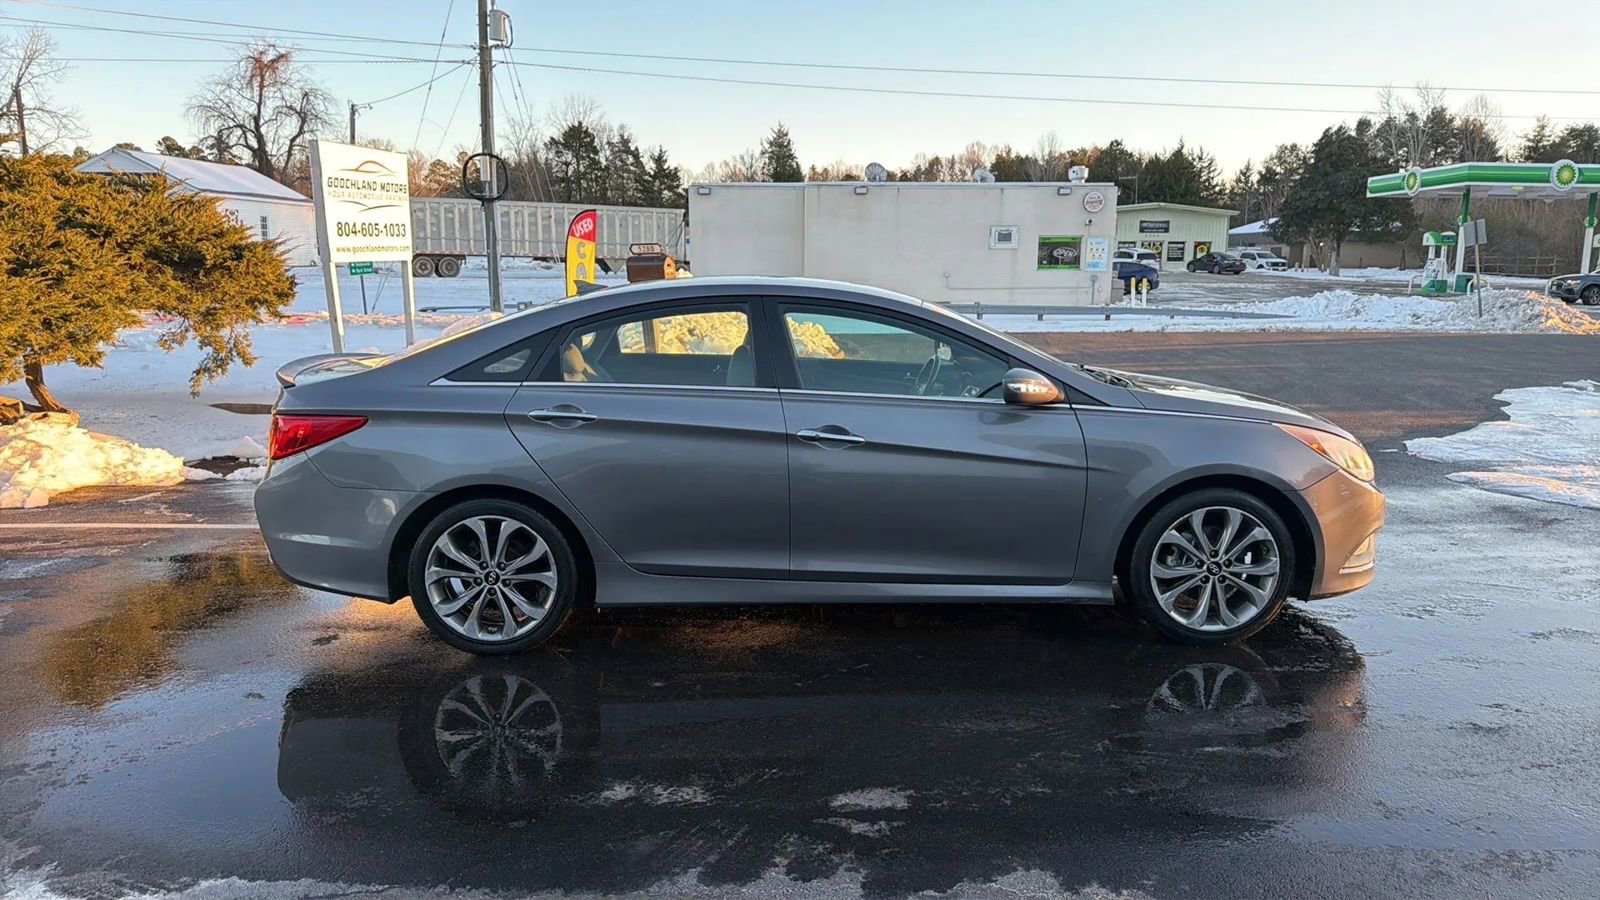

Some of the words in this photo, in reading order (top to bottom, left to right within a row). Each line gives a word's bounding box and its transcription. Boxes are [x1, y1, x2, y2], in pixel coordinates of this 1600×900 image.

[327, 177, 377, 191] GOOCHLAND
[380, 182, 407, 194] MOTORS
[337, 222, 406, 237] 804-605-1033
[572, 218, 593, 237] USED
[336, 245, 410, 255] www.goochlandmotors.com
[1055, 247, 1075, 258] OPEN
